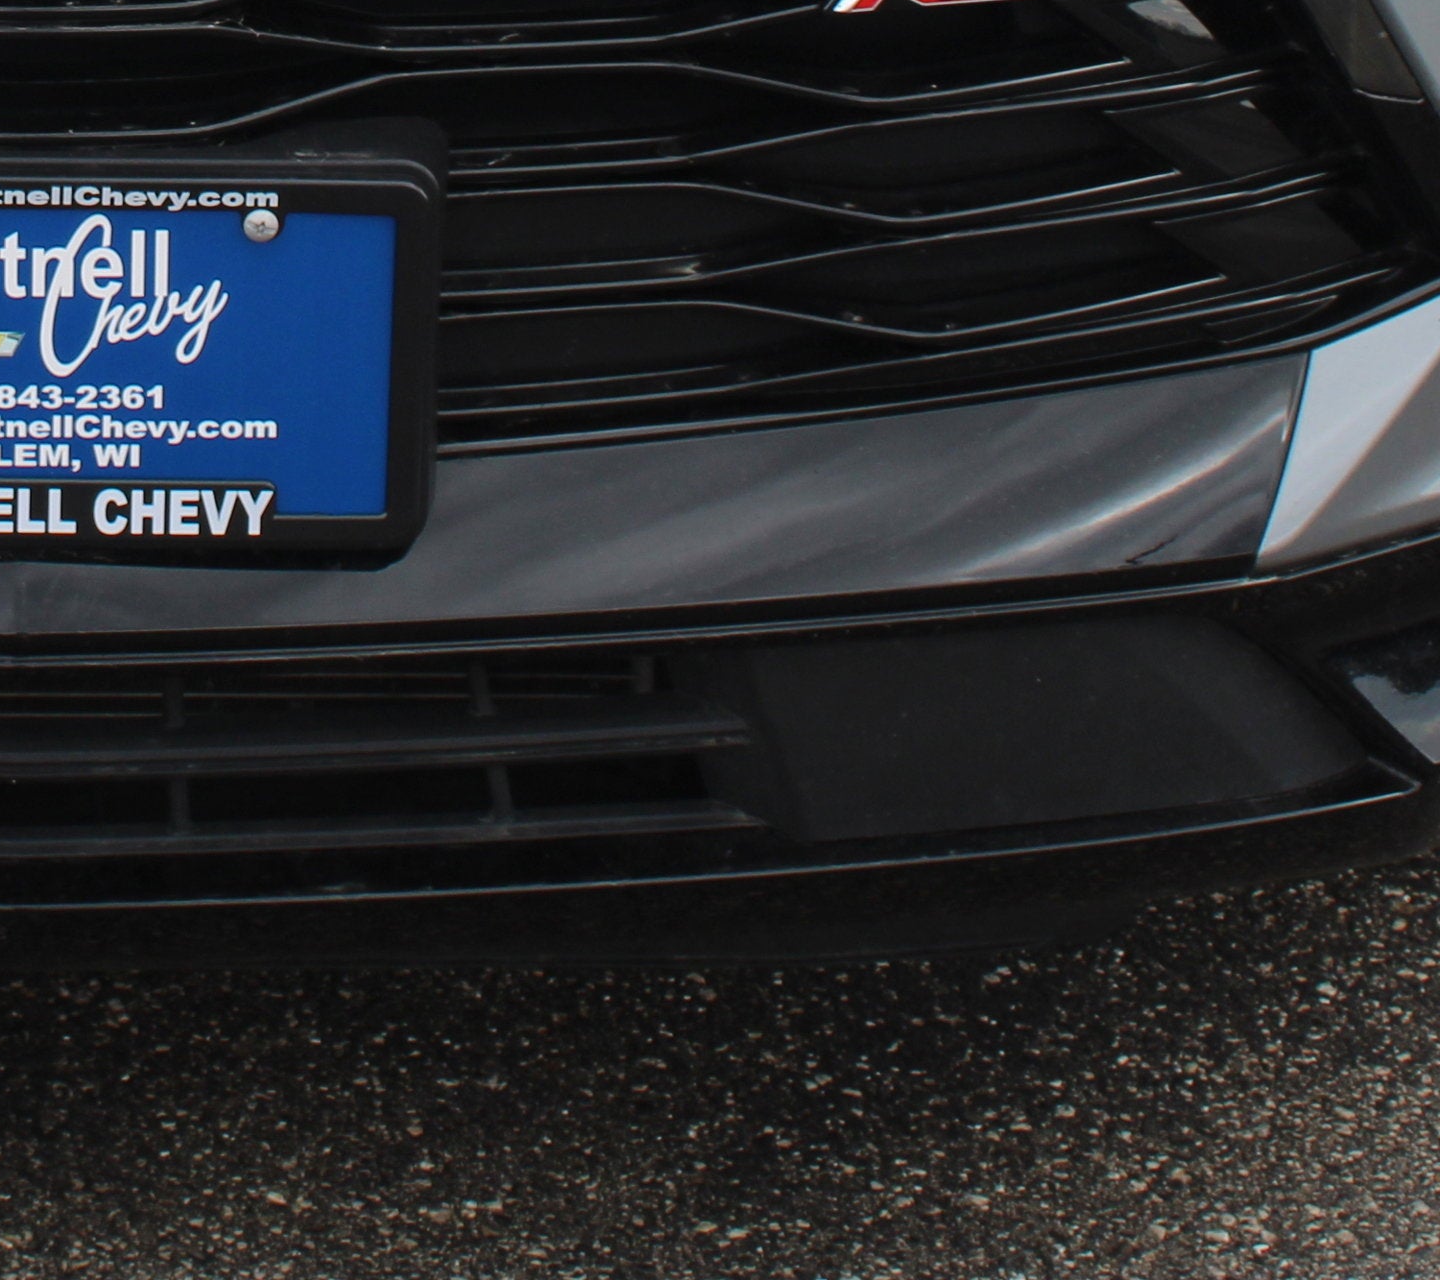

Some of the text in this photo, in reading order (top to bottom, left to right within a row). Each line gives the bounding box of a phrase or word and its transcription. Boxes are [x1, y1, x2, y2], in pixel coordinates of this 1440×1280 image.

[37, 213, 230, 378] Chevy
[92, 444, 142, 469] WI
[92, 488, 275, 536] CHEVY
